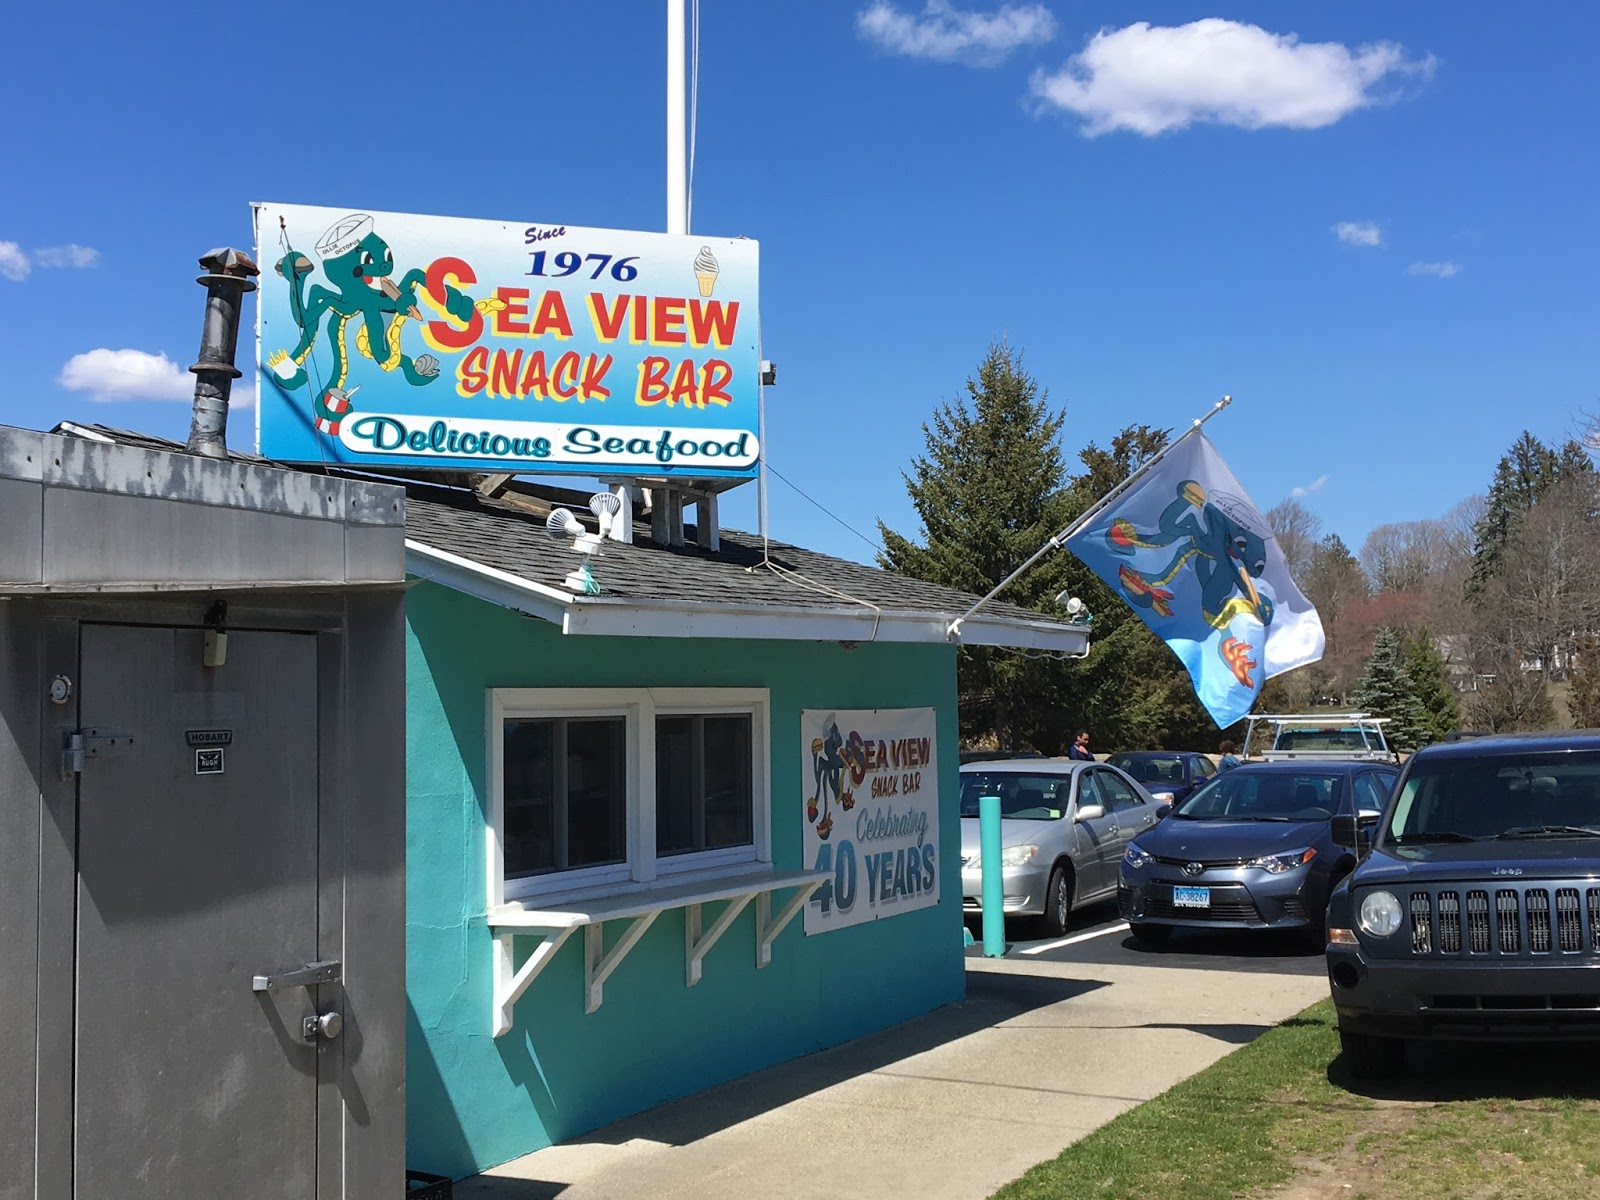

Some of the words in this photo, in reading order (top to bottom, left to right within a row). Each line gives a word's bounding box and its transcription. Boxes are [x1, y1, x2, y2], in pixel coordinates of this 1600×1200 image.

[322, 243, 339, 255] OLLIE
[334, 238, 361, 255] OCTOPUS
[524, 225, 566, 245] Since
[525, 250, 641, 282] 1976
[420, 256, 574, 353] SEA
[585, 291, 740, 350] VIEW
[455, 345, 613, 404] SNACK
[635, 355, 734, 409] BAR
[351, 416, 552, 458] Delicious
[562, 427, 751, 463] Seafood
[1215, 499, 1233, 511] OLLIE
[1222, 508, 1251, 530] OCTOPUS
[191, 732, 229, 742] HOBART
[849, 730, 889, 789] SEA
[890, 737, 932, 773] VIEW
[871, 773, 899, 800] SNACK
[902, 771, 921, 797] BAR
[856, 804, 929, 849] Celebrating
[810, 839, 857, 916] 40
[864, 843, 936, 904] YEARS
[1491, 867, 1523, 876] Jeep
